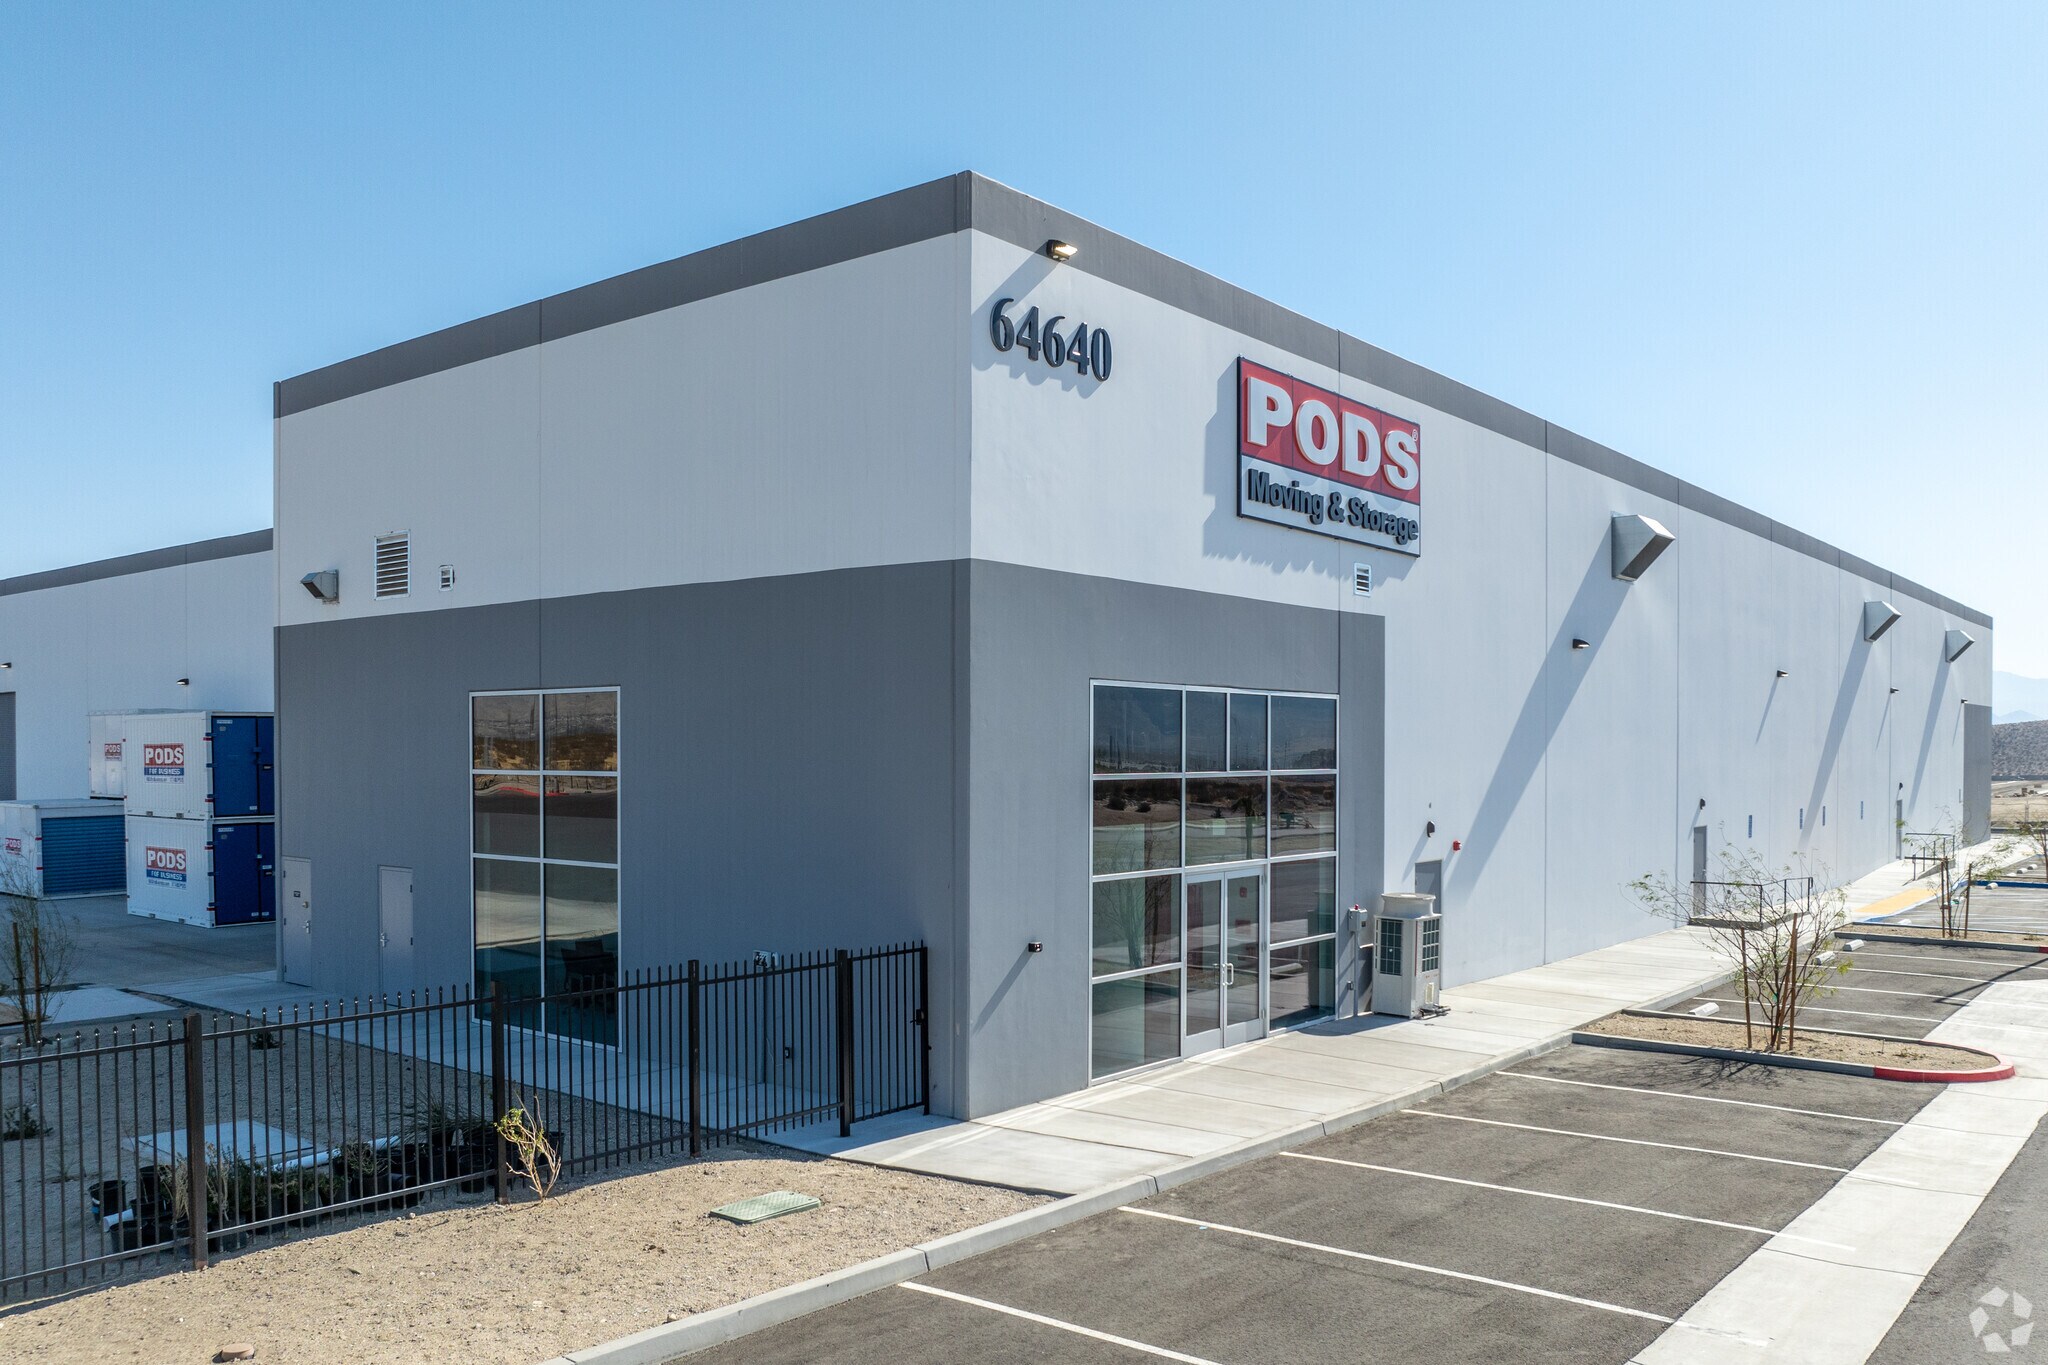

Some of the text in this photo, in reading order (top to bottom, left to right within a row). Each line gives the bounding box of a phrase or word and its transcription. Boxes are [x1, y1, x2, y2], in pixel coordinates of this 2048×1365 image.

[989, 298, 1112, 382] 64640
[1247, 376, 1419, 491] PODS
[1248, 468, 1419, 545] Moving & Storage
[145, 747, 184, 764] PODS
[147, 849, 186, 870] PODS
